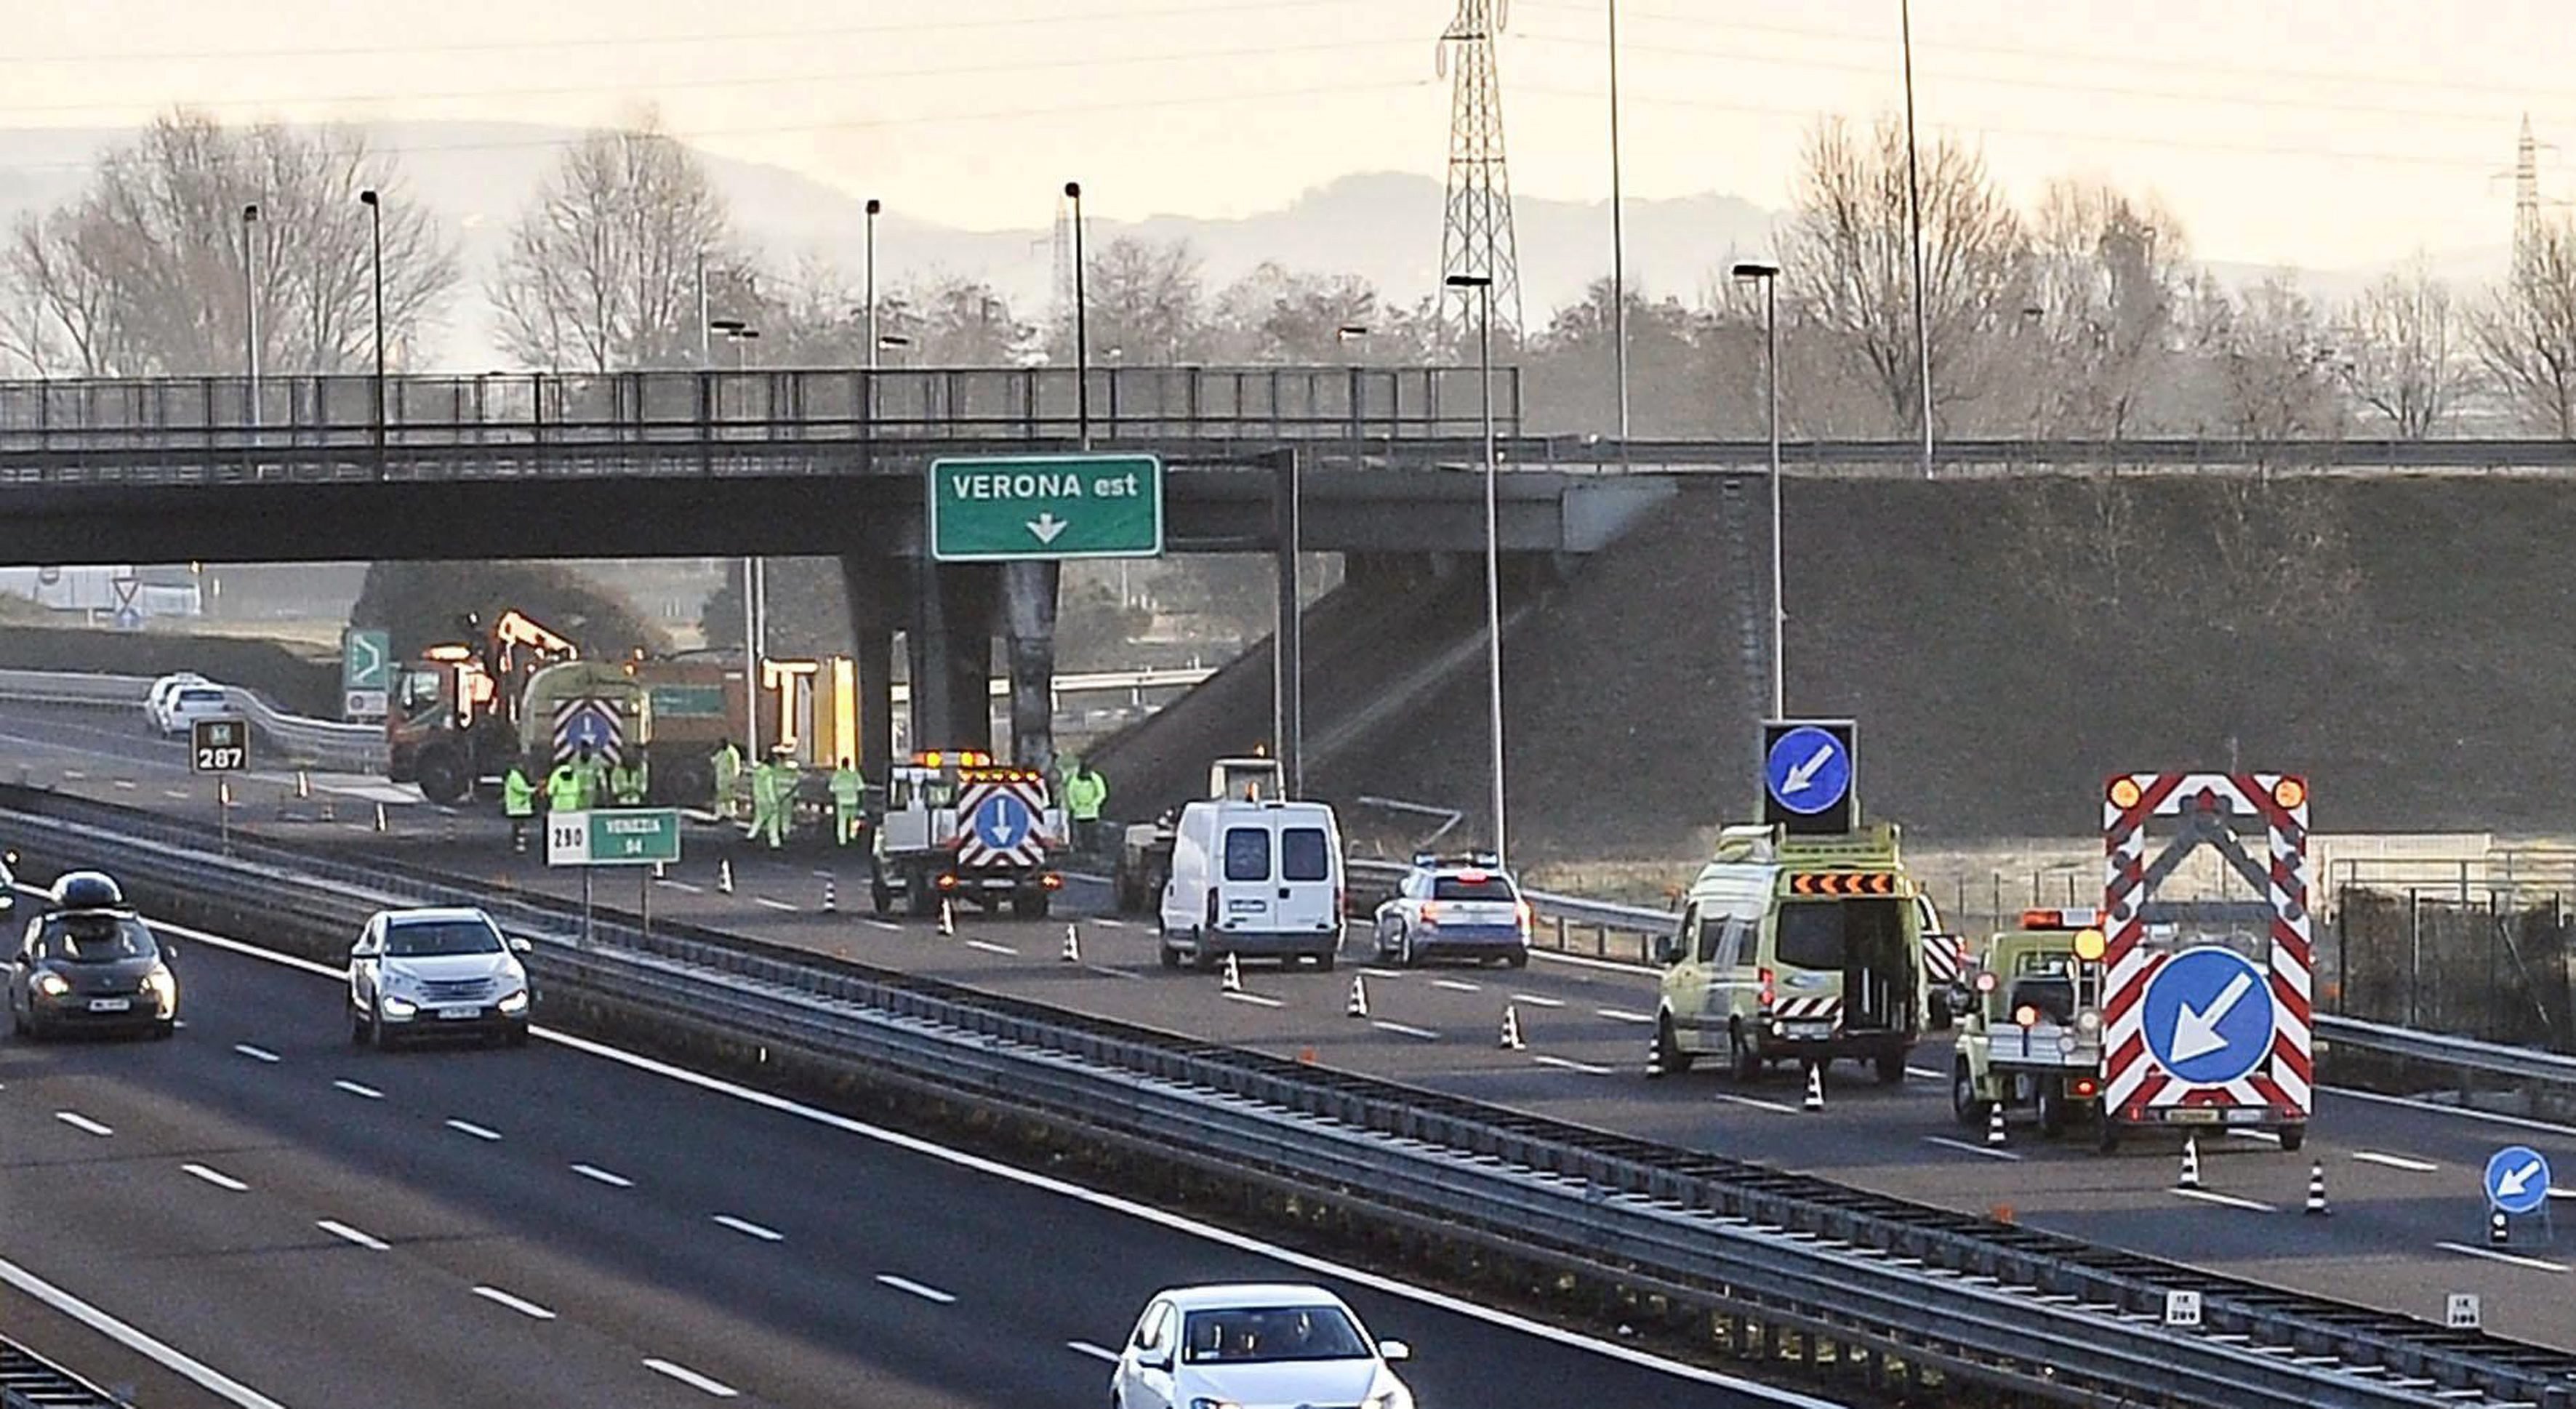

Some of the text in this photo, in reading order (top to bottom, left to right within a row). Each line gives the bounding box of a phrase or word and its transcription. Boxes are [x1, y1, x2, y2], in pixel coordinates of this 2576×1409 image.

[952, 473, 1139, 499] VERONA est
[199, 748, 242, 768] 287
